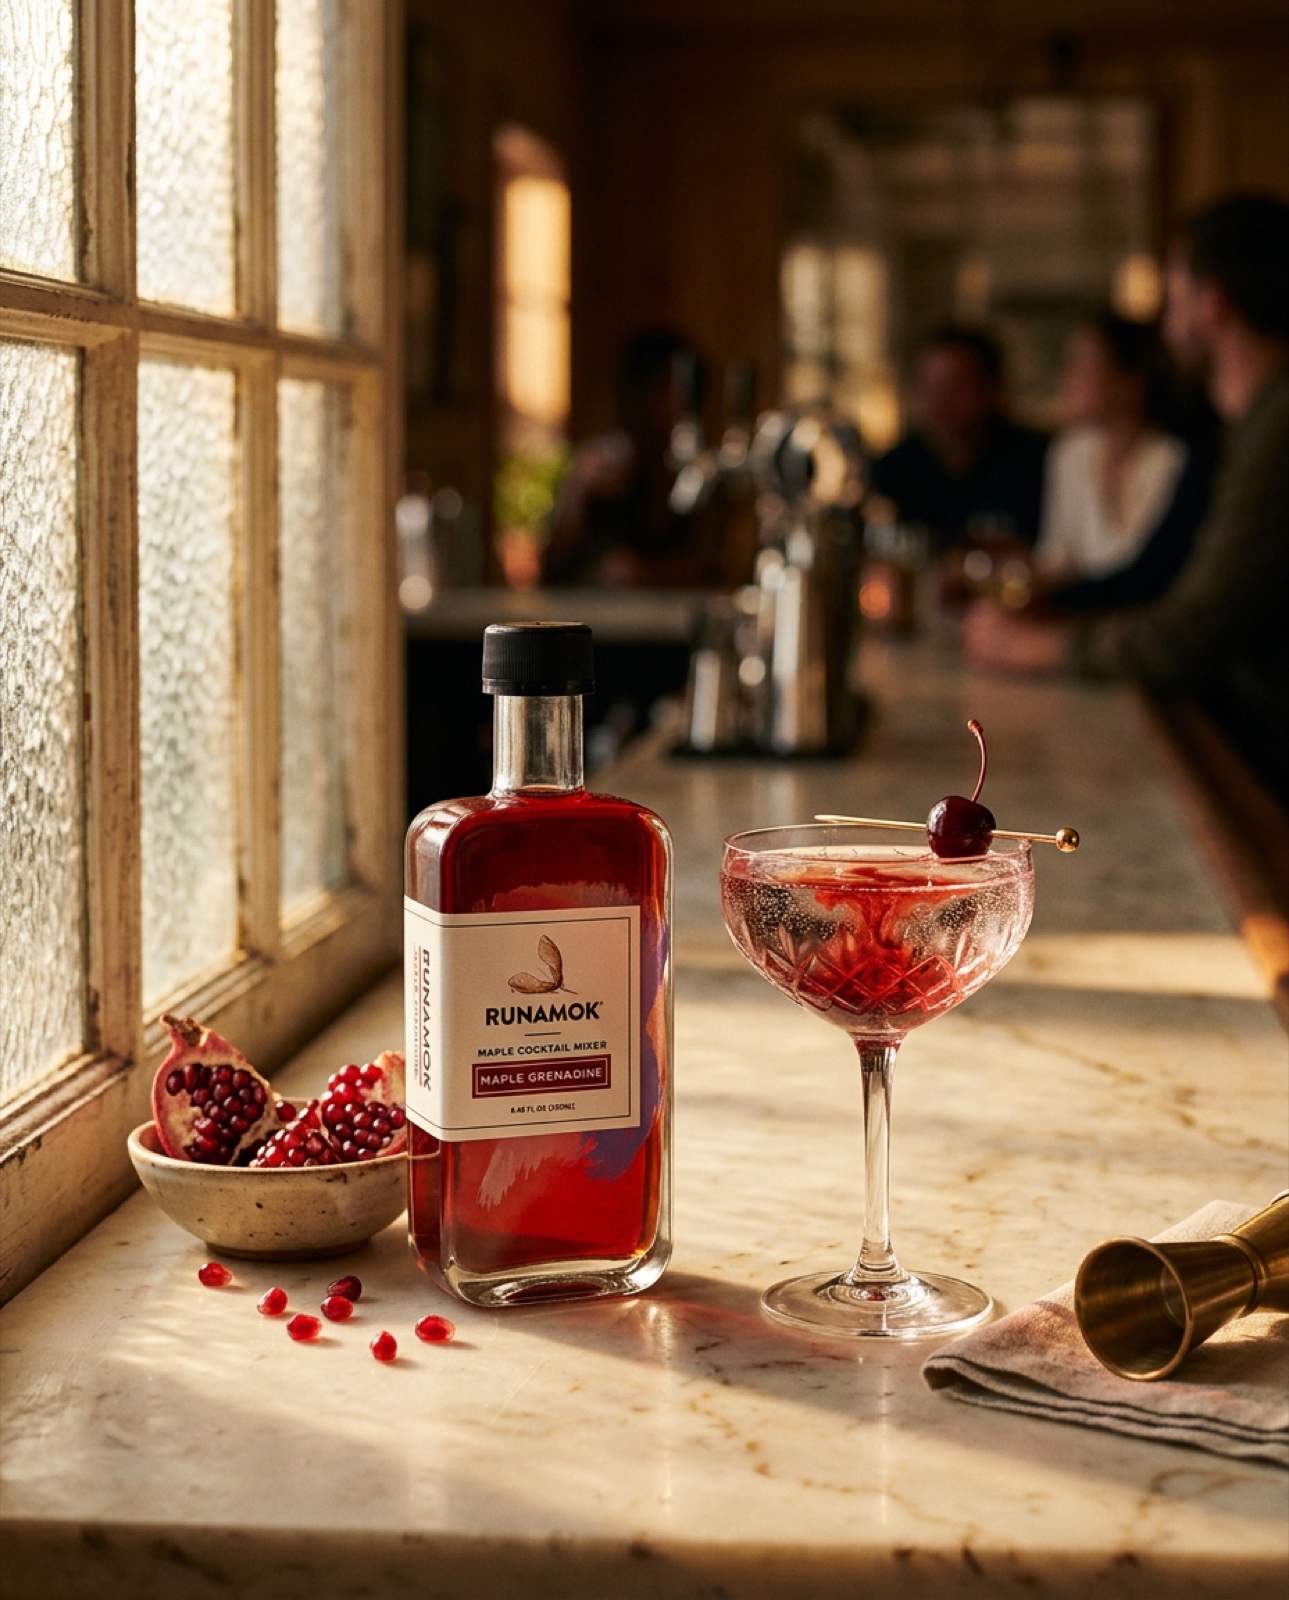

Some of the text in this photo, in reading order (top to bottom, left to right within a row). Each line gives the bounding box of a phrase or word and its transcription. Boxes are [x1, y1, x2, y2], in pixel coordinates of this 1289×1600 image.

[421, 948, 432, 1091] RUNAMOK
[485, 1001, 600, 1026] RUNAMOK
[477, 1041, 607, 1058] MAPLE COCKTAIL MIXER
[480, 1067, 603, 1086] MAPLE GRENADINE
